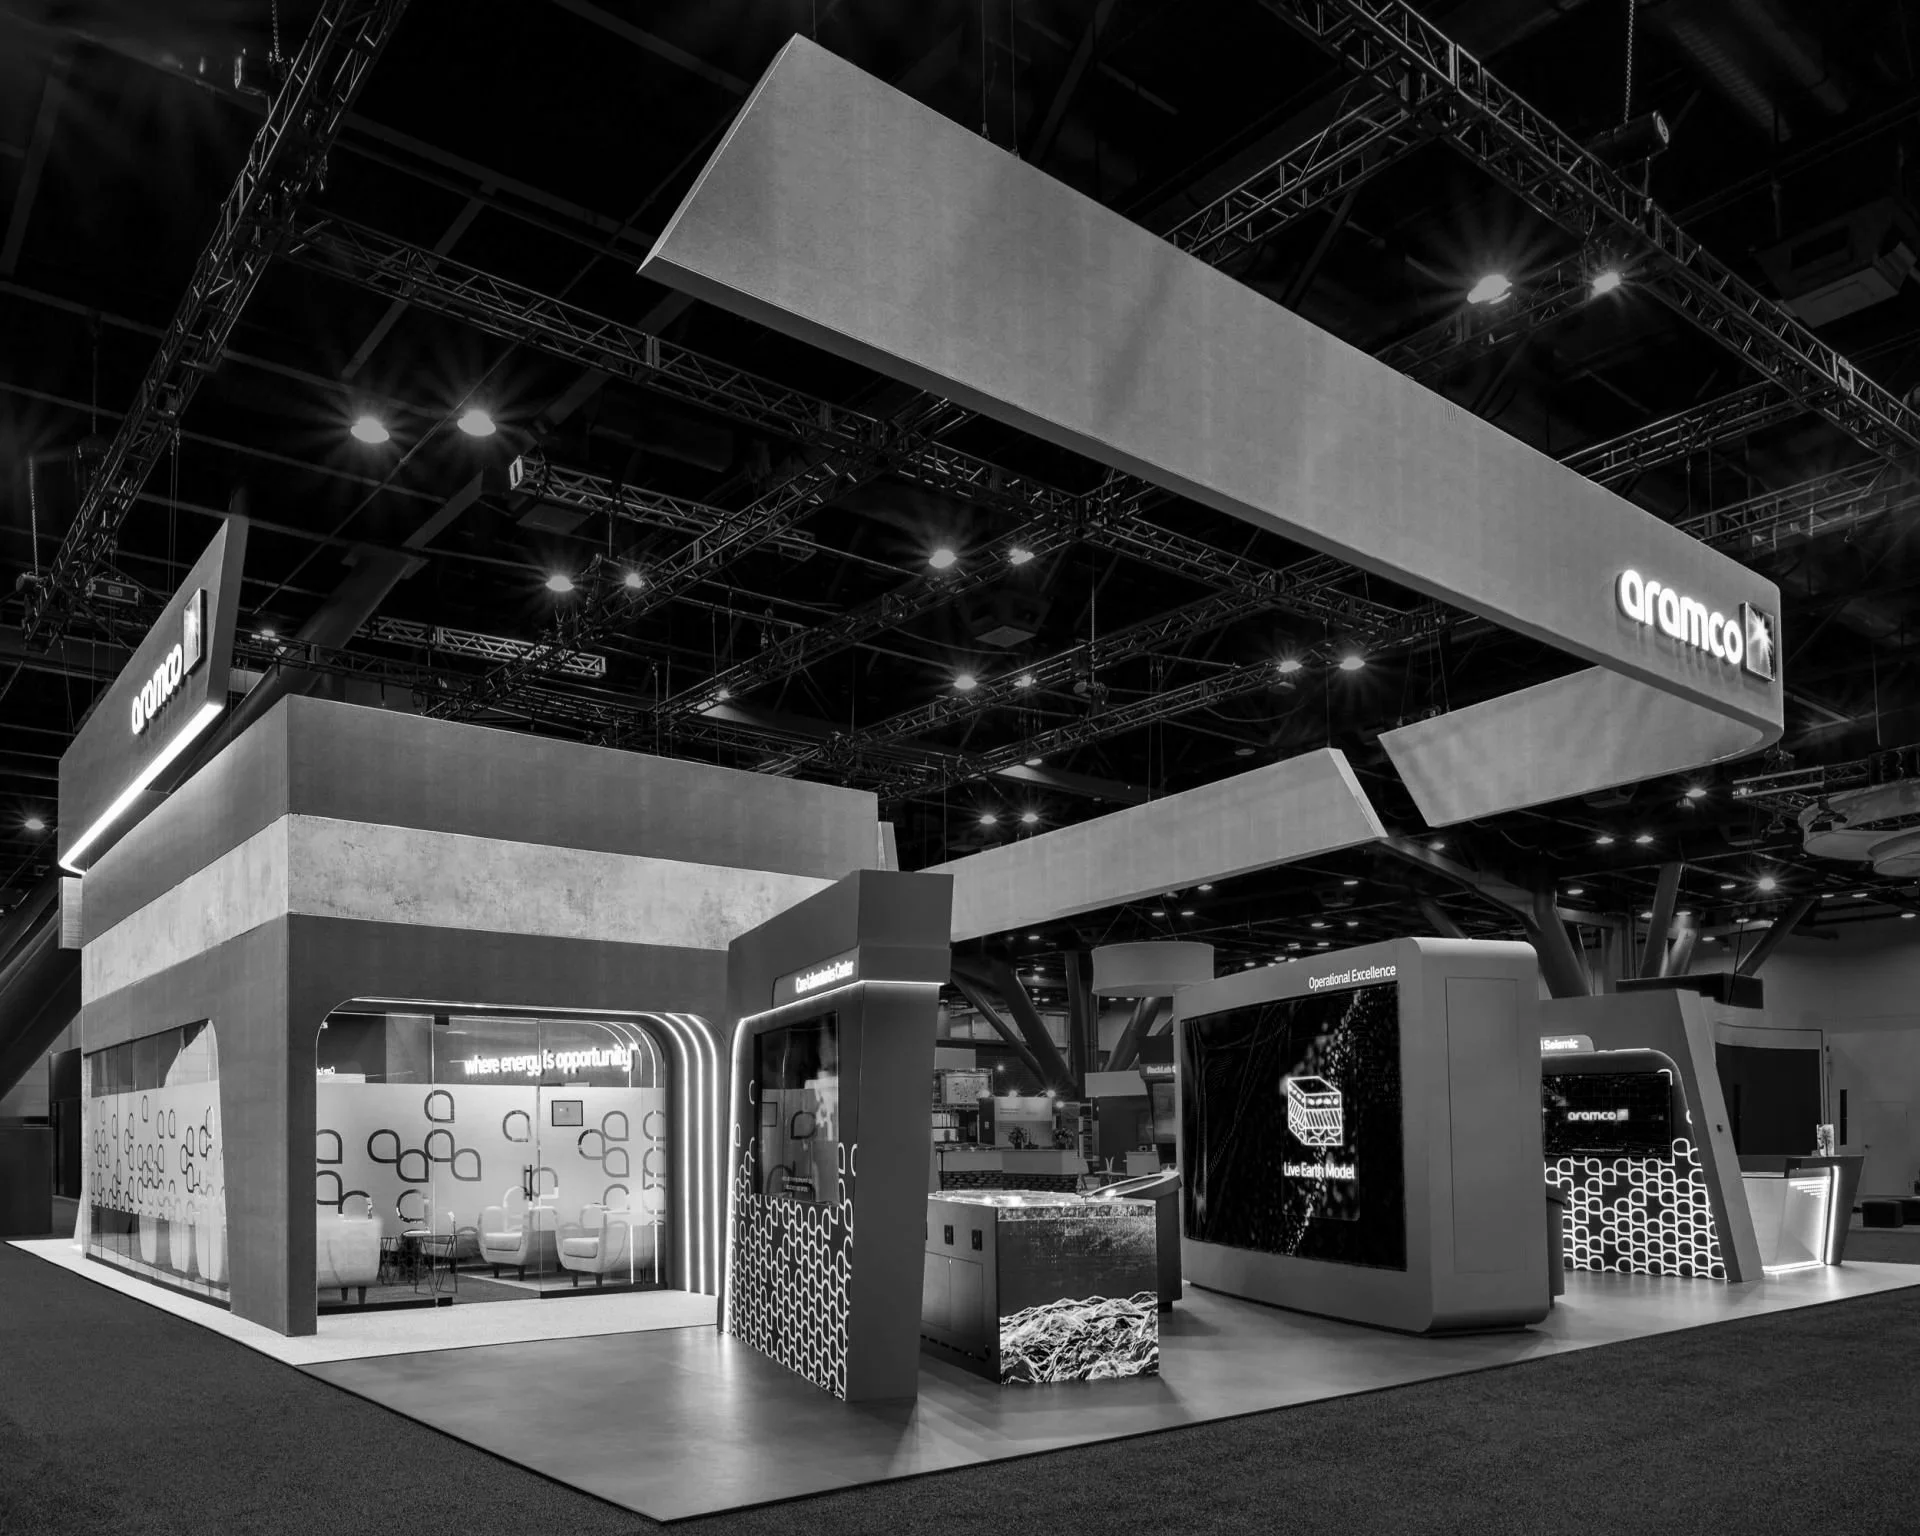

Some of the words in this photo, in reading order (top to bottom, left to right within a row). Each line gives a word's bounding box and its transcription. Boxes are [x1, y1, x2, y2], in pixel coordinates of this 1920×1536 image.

[1620, 569, 1743, 665] aramco
[131, 643, 182, 735] aramco
[1308, 970, 1350, 992] Operational
[1351, 965, 1396, 982] Excellence
[1543, 1038, 1579, 1050] Seismic
[464, 1054, 500, 1075] where
[501, 1053, 543, 1076] energy
[543, 1049, 556, 1070] is
[1567, 1111, 1616, 1121] aramco
[1283, 1161, 1300, 1176] Live
[1301, 1161, 1324, 1178] Earth
[1325, 1162, 1355, 1179] Model
